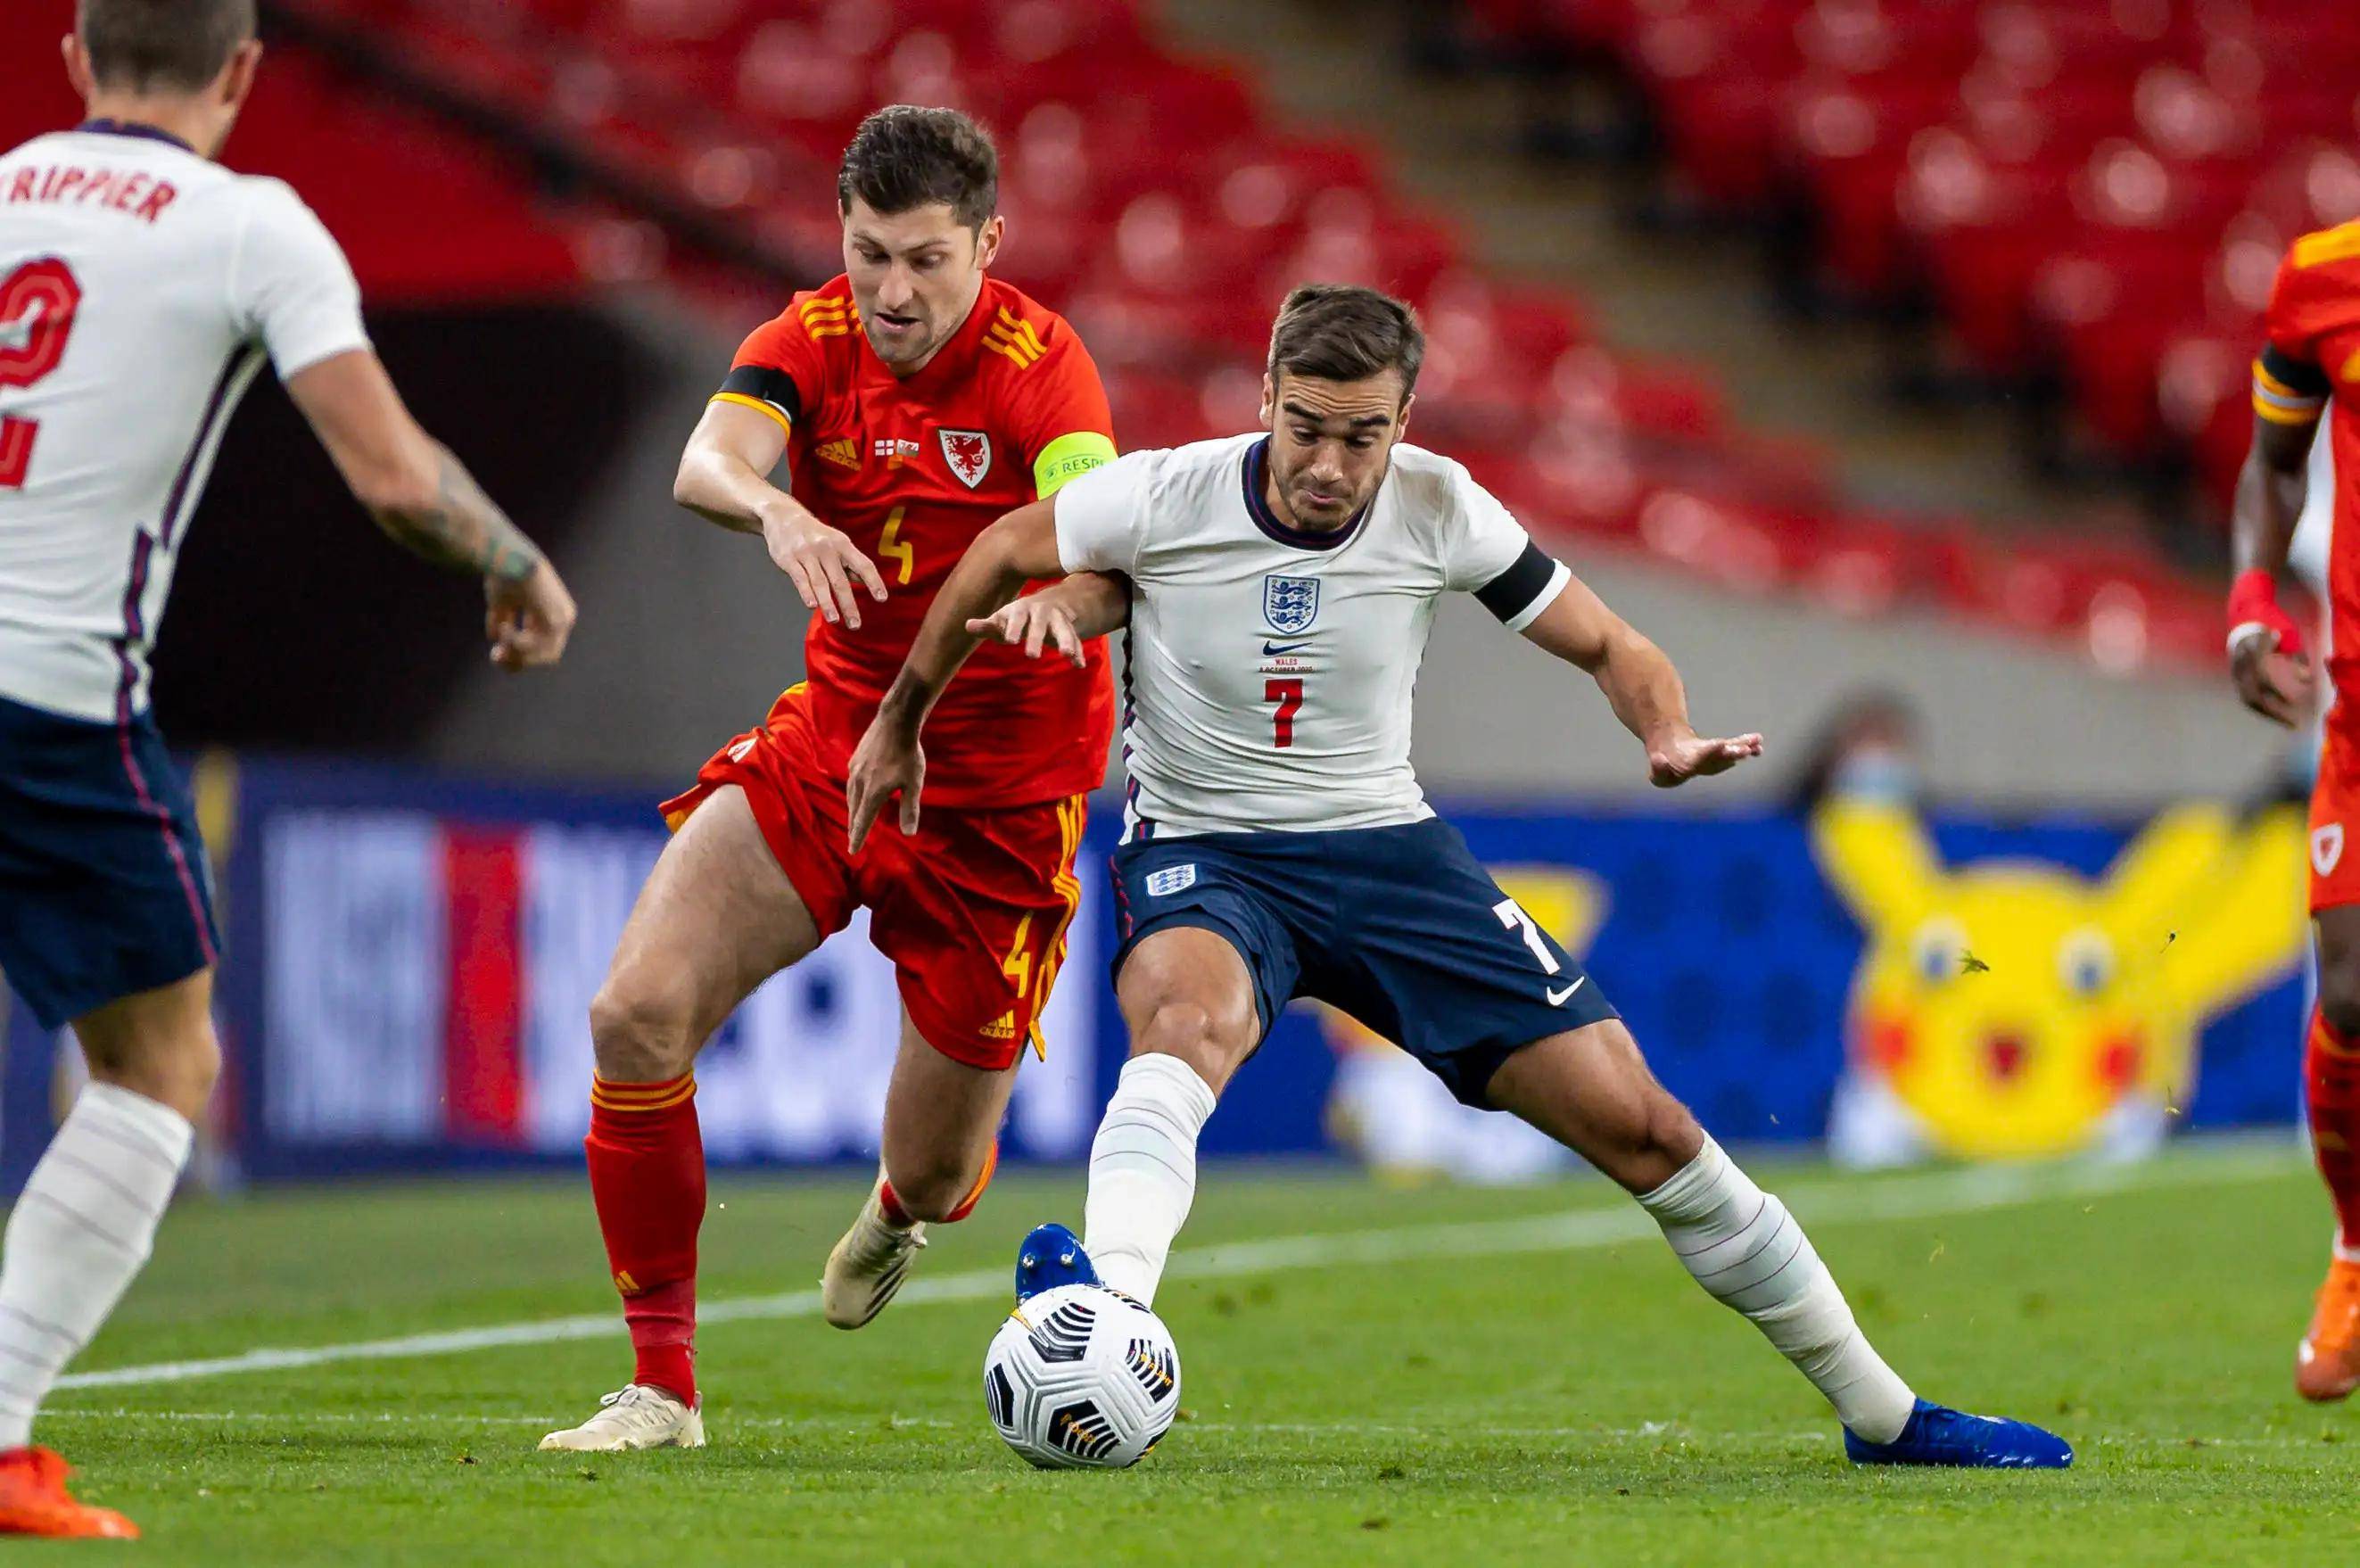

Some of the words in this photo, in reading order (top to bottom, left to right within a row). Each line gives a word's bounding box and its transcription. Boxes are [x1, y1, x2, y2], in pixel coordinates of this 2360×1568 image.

[0, 164, 177, 223] RIPPIER
[878, 506, 913, 585] 4
[1265, 679, 1303, 748] 7
[1003, 910, 1035, 999] 4
[1491, 898, 1560, 975] 7
